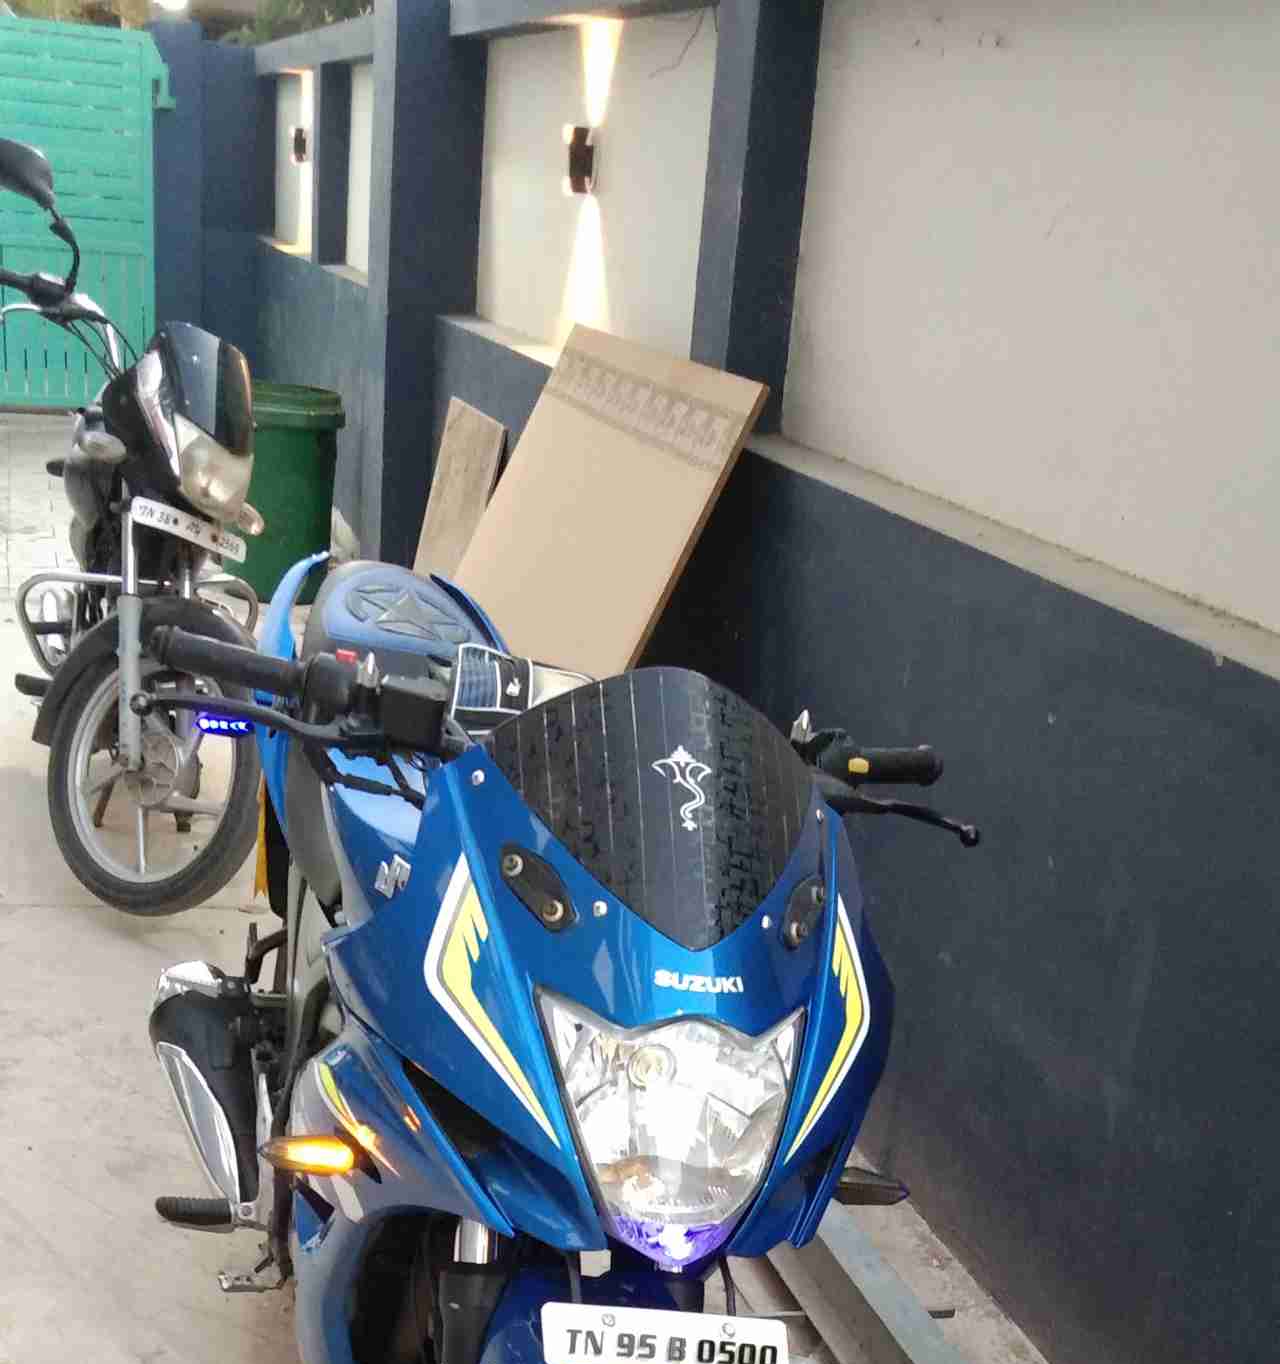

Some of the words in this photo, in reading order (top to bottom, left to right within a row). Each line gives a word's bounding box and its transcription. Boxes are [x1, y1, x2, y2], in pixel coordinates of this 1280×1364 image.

[654, 969, 744, 993] SUZUKI
[566, 1329, 605, 1356] TN
[616, 1333, 657, 1360] 95
[667, 1337, 687, 1362] B
